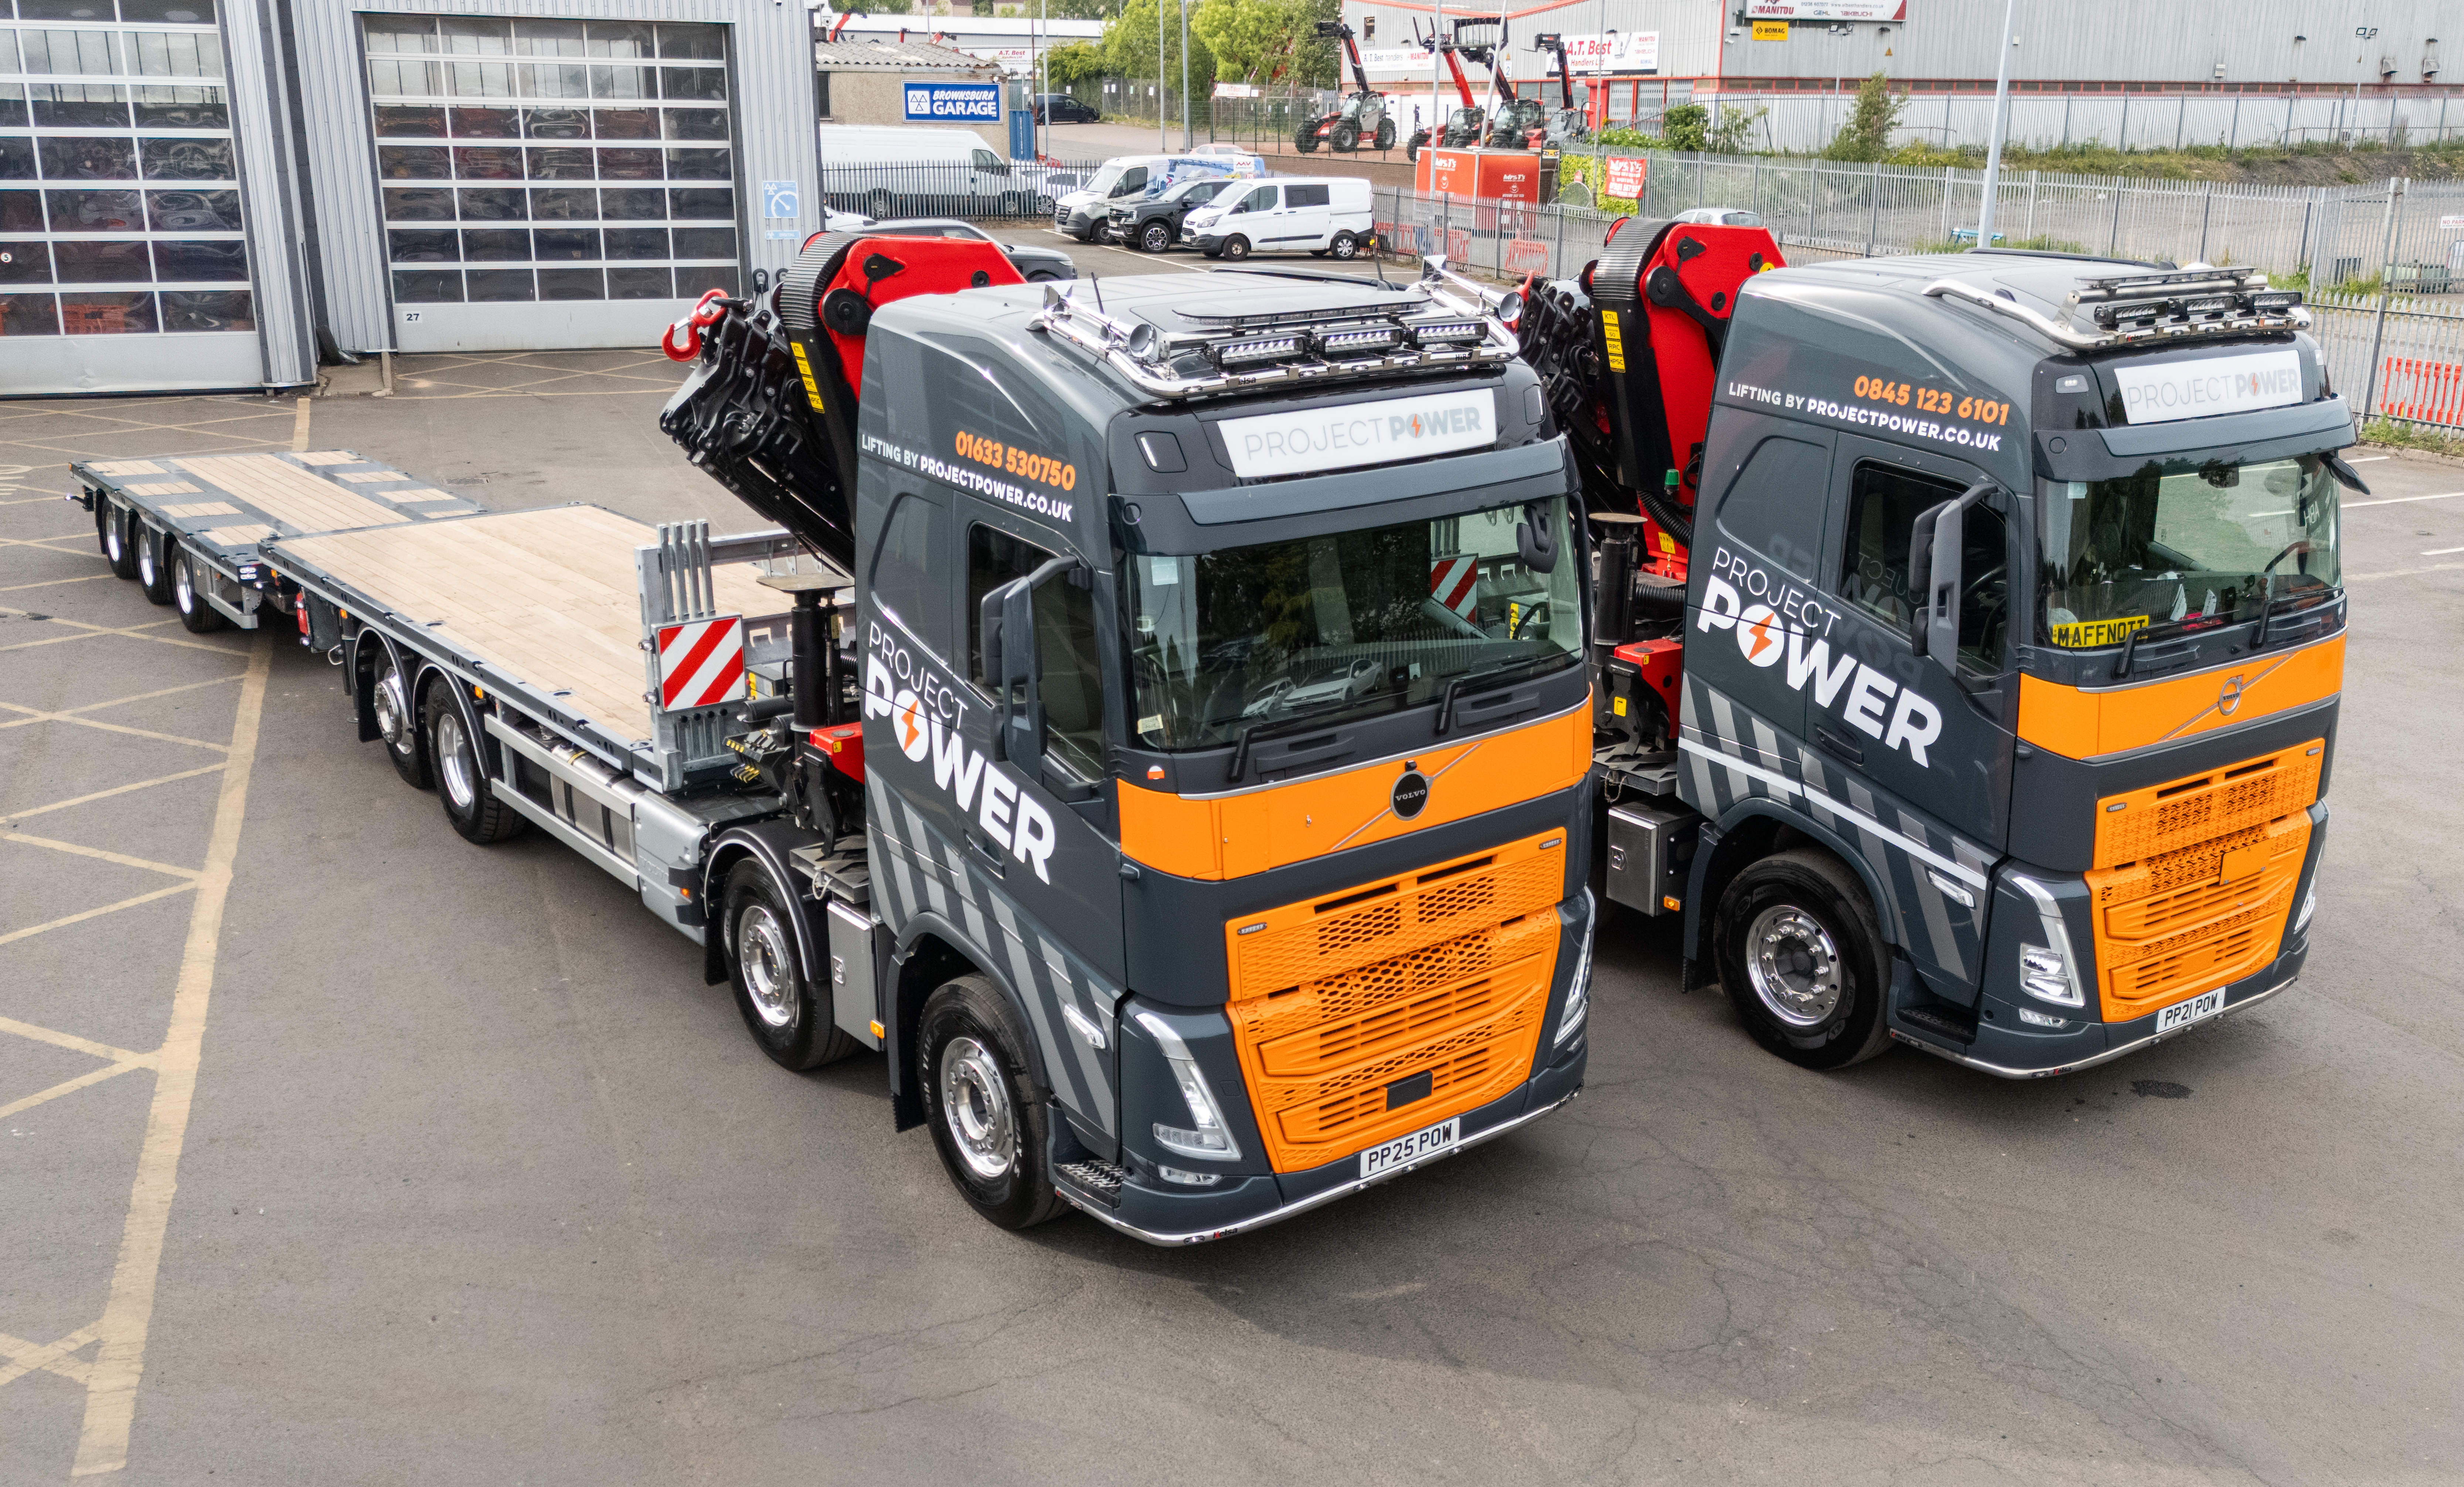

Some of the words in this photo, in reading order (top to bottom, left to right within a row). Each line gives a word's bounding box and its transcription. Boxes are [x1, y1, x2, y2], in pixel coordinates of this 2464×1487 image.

[1758, 6, 1794, 14] MANITOU
[1588, 40, 1612, 55] Best
[1506, 66, 1510, 76] 2
[932, 91, 996, 101] BROWNSBURN
[933, 102, 997, 115] GARAGE
[1238, 377, 1256, 385] elsa
[1854, 376, 1911, 406] 0845
[1916, 388, 1953, 414] 123
[1957, 397, 2009, 426] 6101
[2127, 375, 2232, 412] PROJECT
[2235, 368, 2299, 398] POWER
[1244, 417, 1386, 461] PROJECT
[1388, 406, 1483, 443] POWER
[1729, 382, 1781, 406] LIFTING
[1785, 394, 1805, 410] BY
[1807, 398, 2002, 452] PROJECTPOWER.CO.UK
[862, 434, 901, 463] LIFTING
[903, 449, 919, 468] BY
[920, 455, 1072, 523] PROJECTPOWER.CO.UK
[955, 431, 1003, 468] 01633
[1005, 447, 1076, 491] 530750
[1712, 546, 1841, 638] PROJECT
[869, 620, 969, 730] PROJECT
[1697, 574, 1943, 768] POWER
[865, 652, 1055, 885] POWER
[1395, 789, 1426, 801] VOLVO
[2164, 1002, 2193, 1027] PP21
[2195, 992, 2218, 1016] POW
[1368, 1137, 1415, 1171] PP25
[1418, 1123, 1452, 1152] POW
[1213, 1228, 1238, 1239] Kelsa
